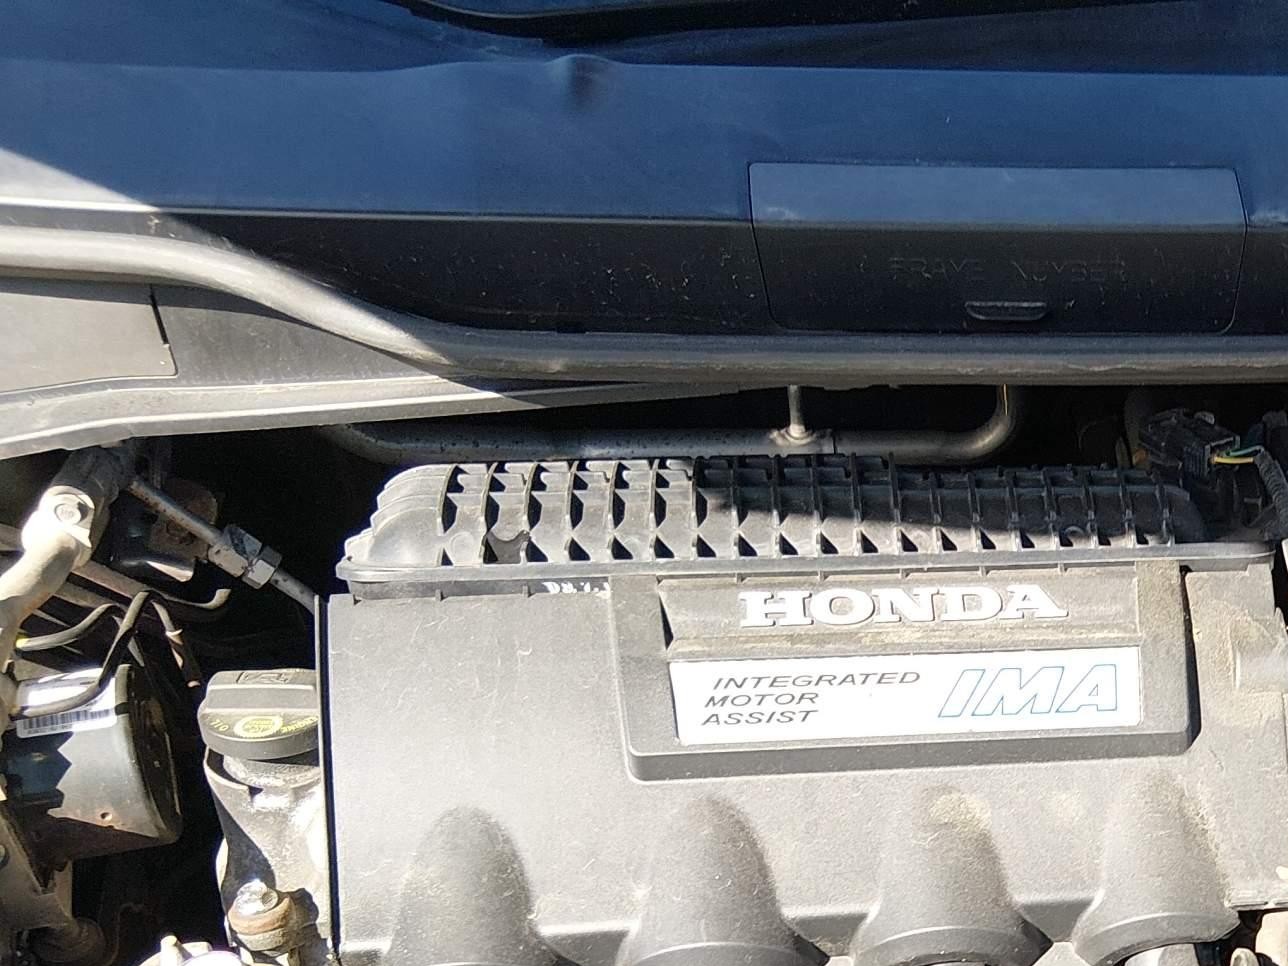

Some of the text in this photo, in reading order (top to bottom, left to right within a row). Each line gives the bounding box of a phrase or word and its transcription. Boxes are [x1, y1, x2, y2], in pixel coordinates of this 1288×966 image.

[739, 584, 1068, 628] HONDA
[712, 671, 921, 690] INTEGRATED
[938, 663, 1118, 718] IMA
[704, 692, 820, 708] MOTOR
[210, 719, 229, 733] OIL
[701, 710, 819, 726] ASSIST
